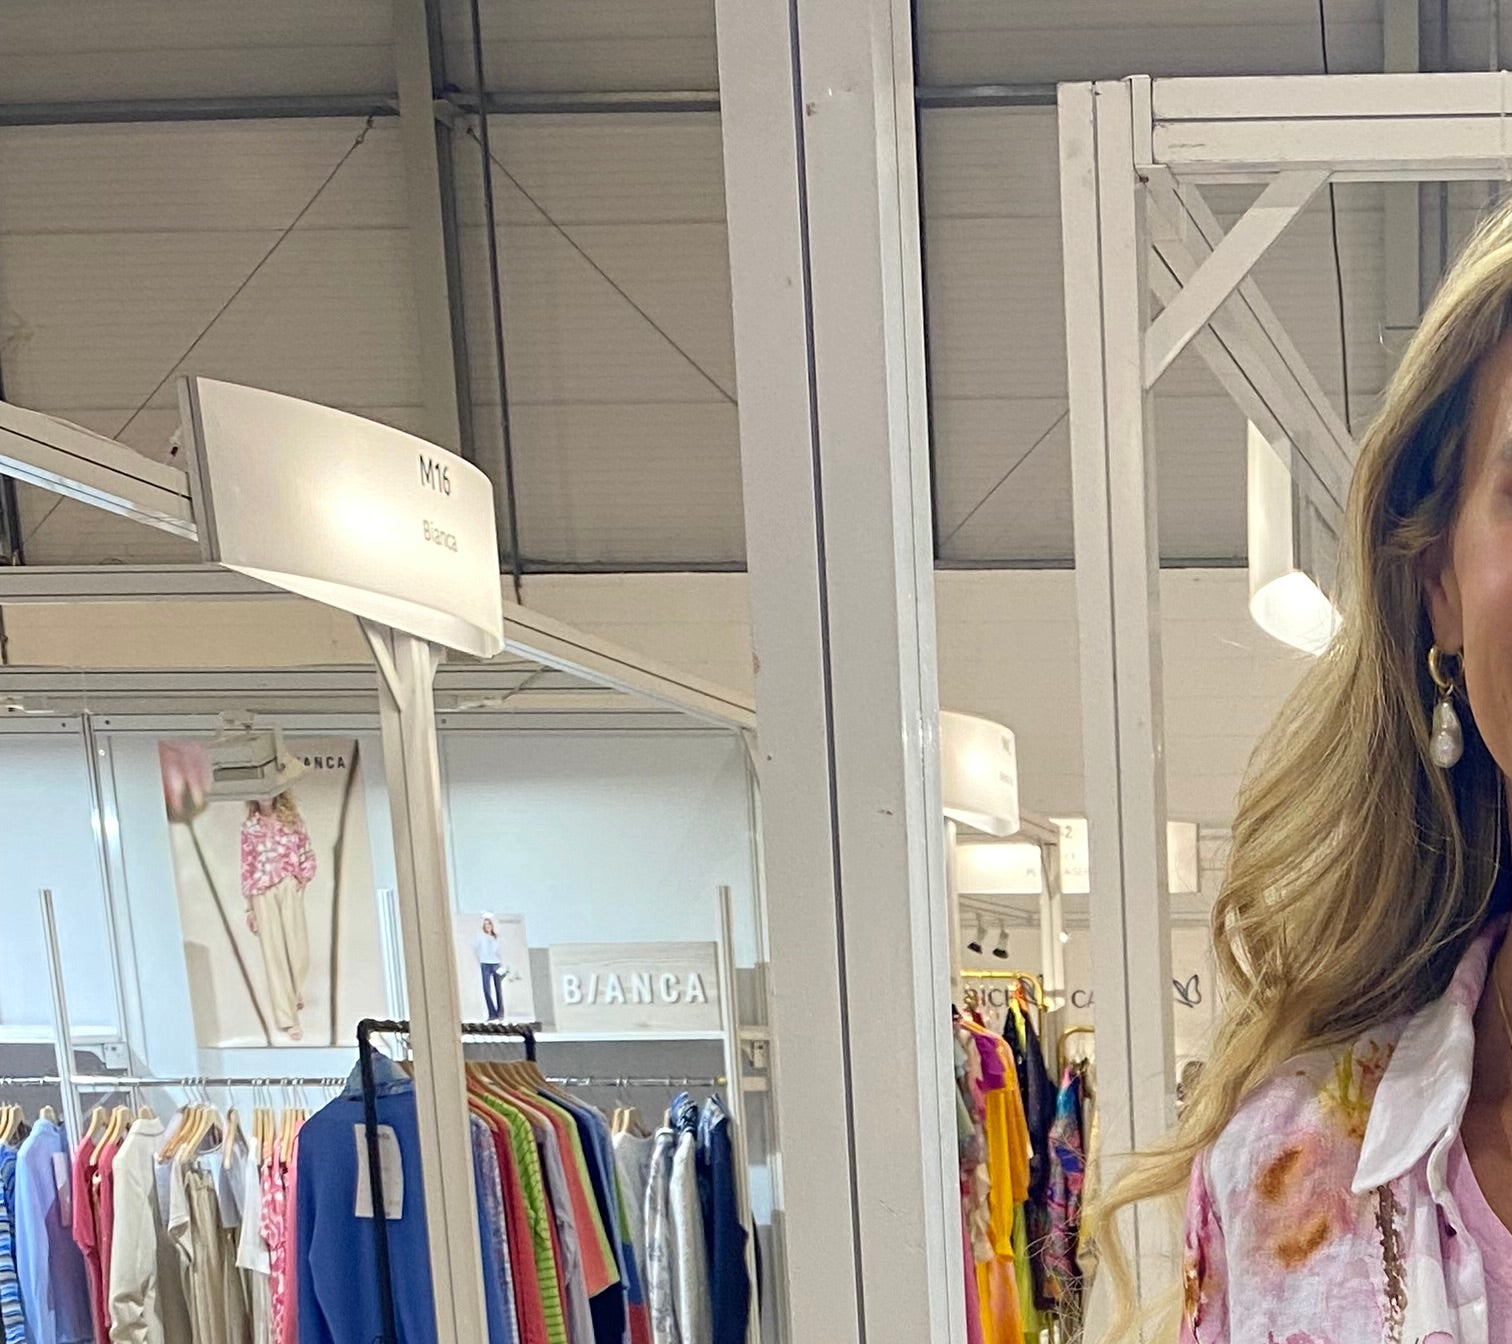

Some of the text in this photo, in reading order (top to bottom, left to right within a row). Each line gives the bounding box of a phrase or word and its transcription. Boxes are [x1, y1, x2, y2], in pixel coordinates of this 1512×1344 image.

[419, 455, 451, 496] M16
[423, 519, 458, 552] Bianca
[296, 756, 346, 769] ANCA
